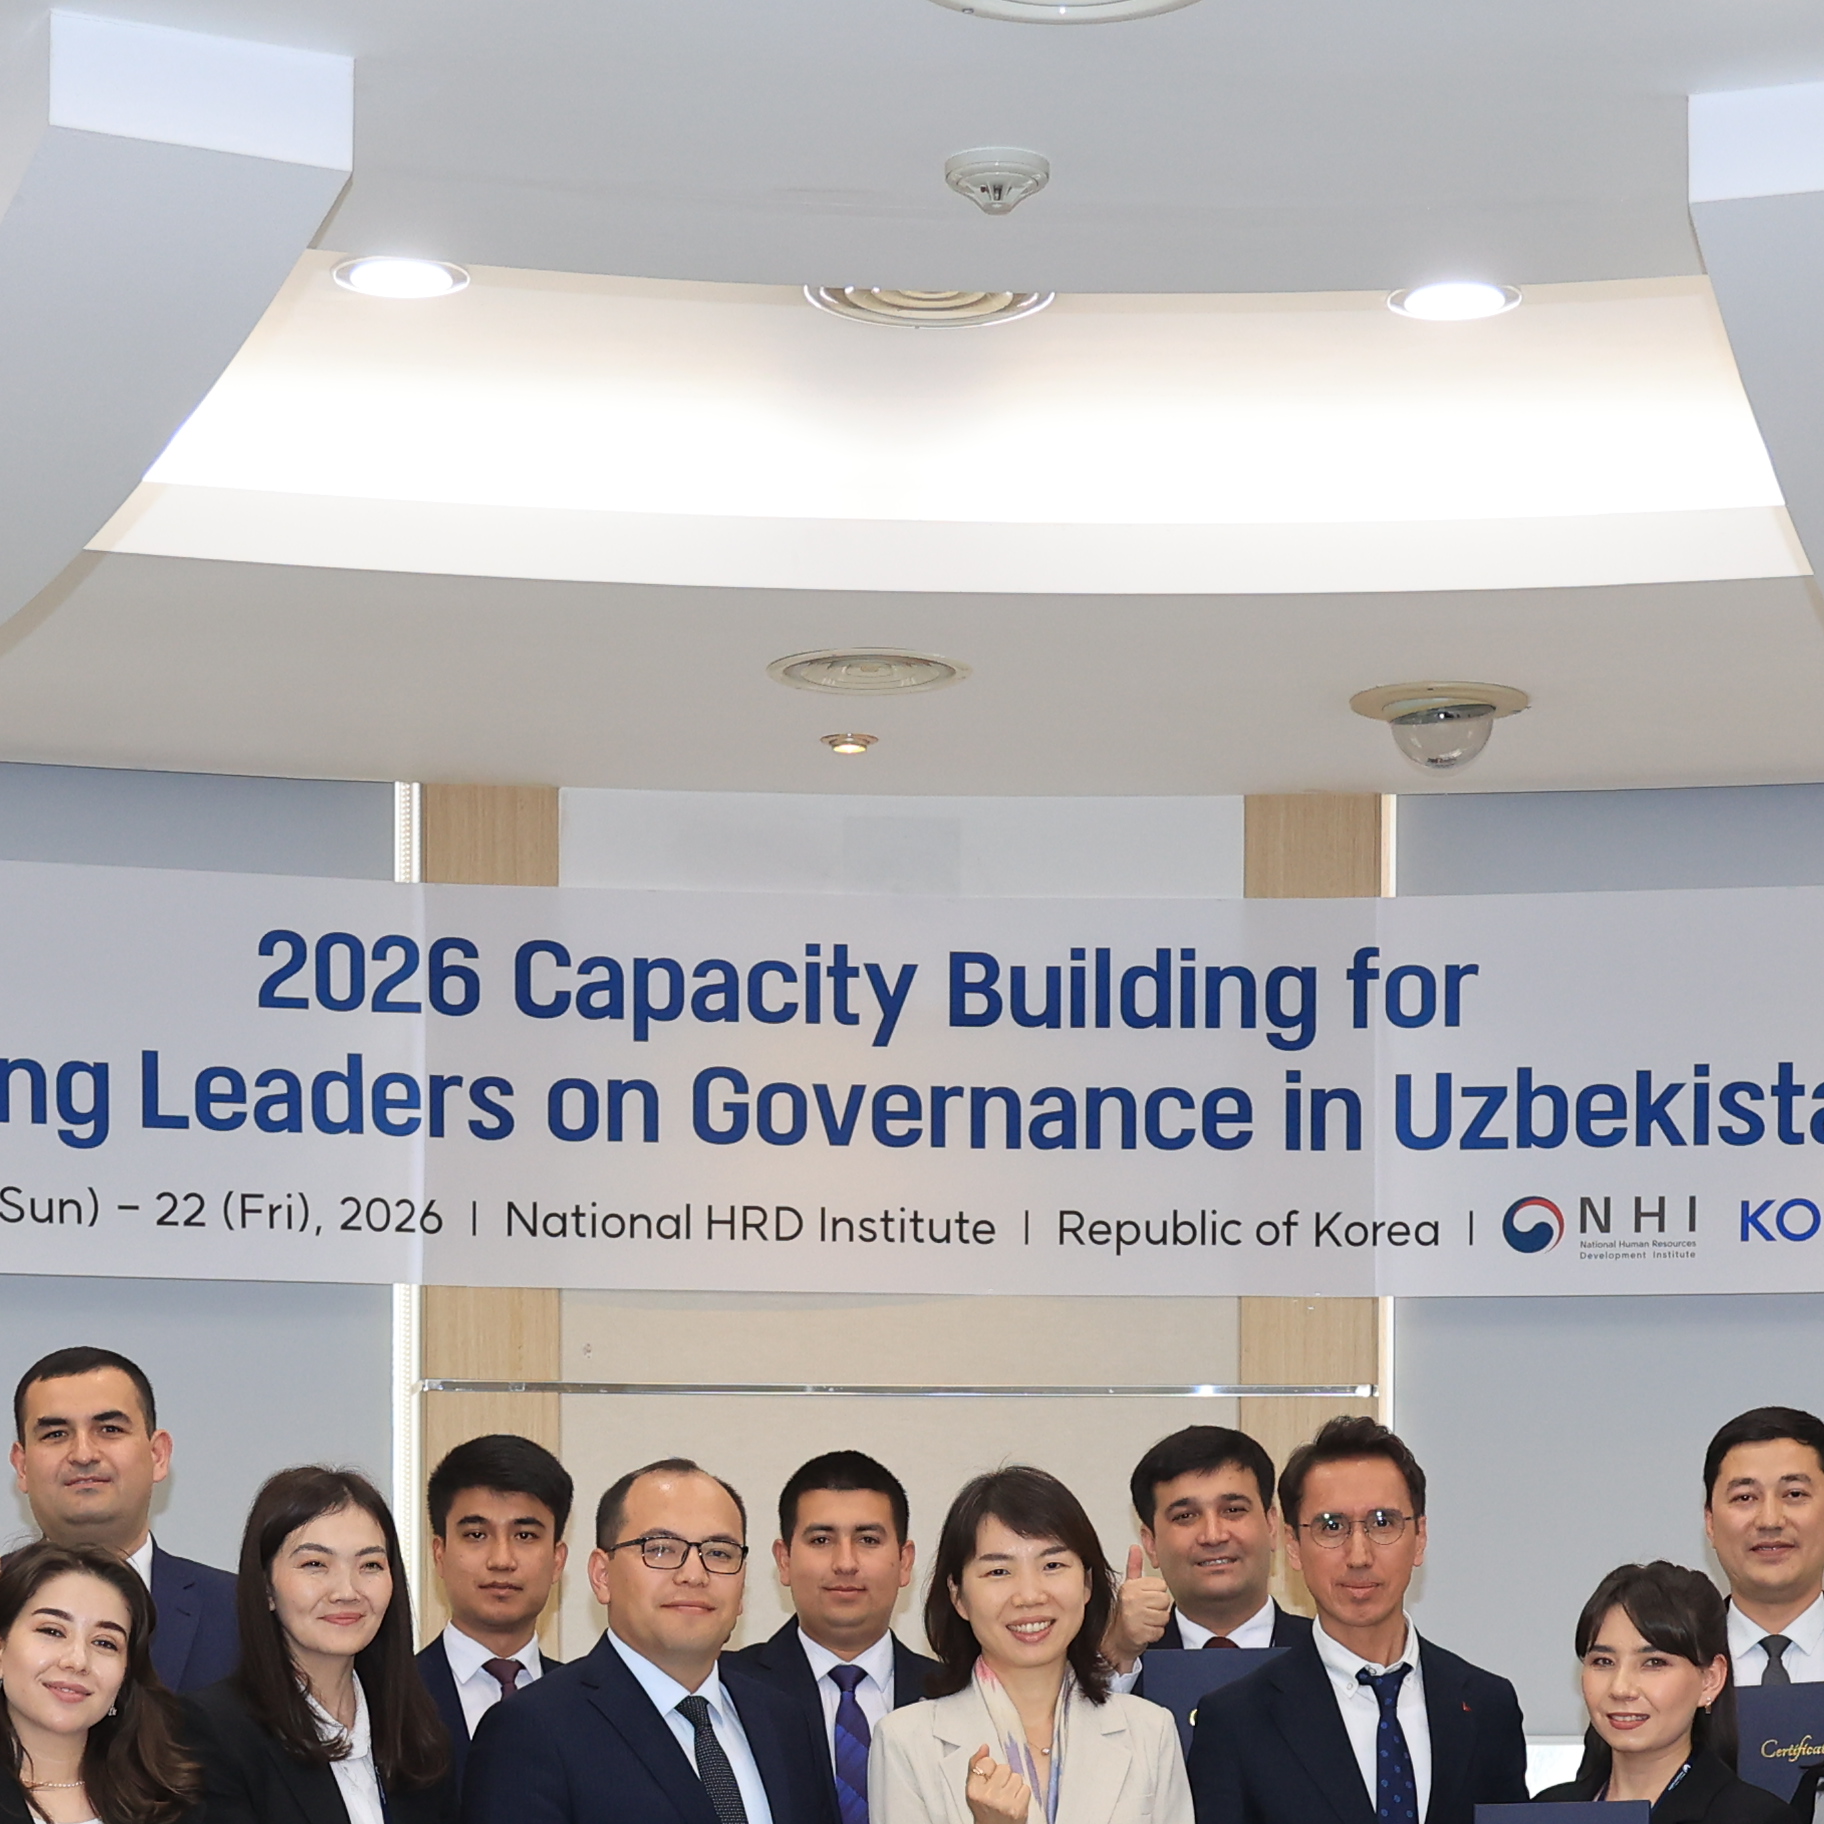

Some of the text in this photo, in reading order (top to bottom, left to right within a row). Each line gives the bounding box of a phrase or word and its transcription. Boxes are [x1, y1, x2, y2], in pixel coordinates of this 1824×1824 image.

[258, 930, 1479, 1051] 2026 Capacity Building for
[142, 1050, 514, 1141] Leaders
[548, 1078, 659, 1143] on
[693, 1066, 1253, 1151] Governance
[1286, 1070, 1361, 1151] in
[156, 1192, 205, 1227] 22
[224, 1191, 322, 1236] (Fri),
[341, 1197, 443, 1234] 2026
[507, 1201, 690, 1240] National
[708, 1205, 803, 1241] HRD
[821, 1207, 995, 1244] Institute
[1059, 1209, 1242, 1256] Republic
[1256, 1210, 1299, 1246] of
[1315, 1212, 1439, 1247] Korea
[1580, 1196, 1696, 1234] NHI
[1580, 1241, 1616, 1249] National
[1652, 1240, 1696, 1248] Resources
[1580, 1250, 1695, 1260] Development Institute
